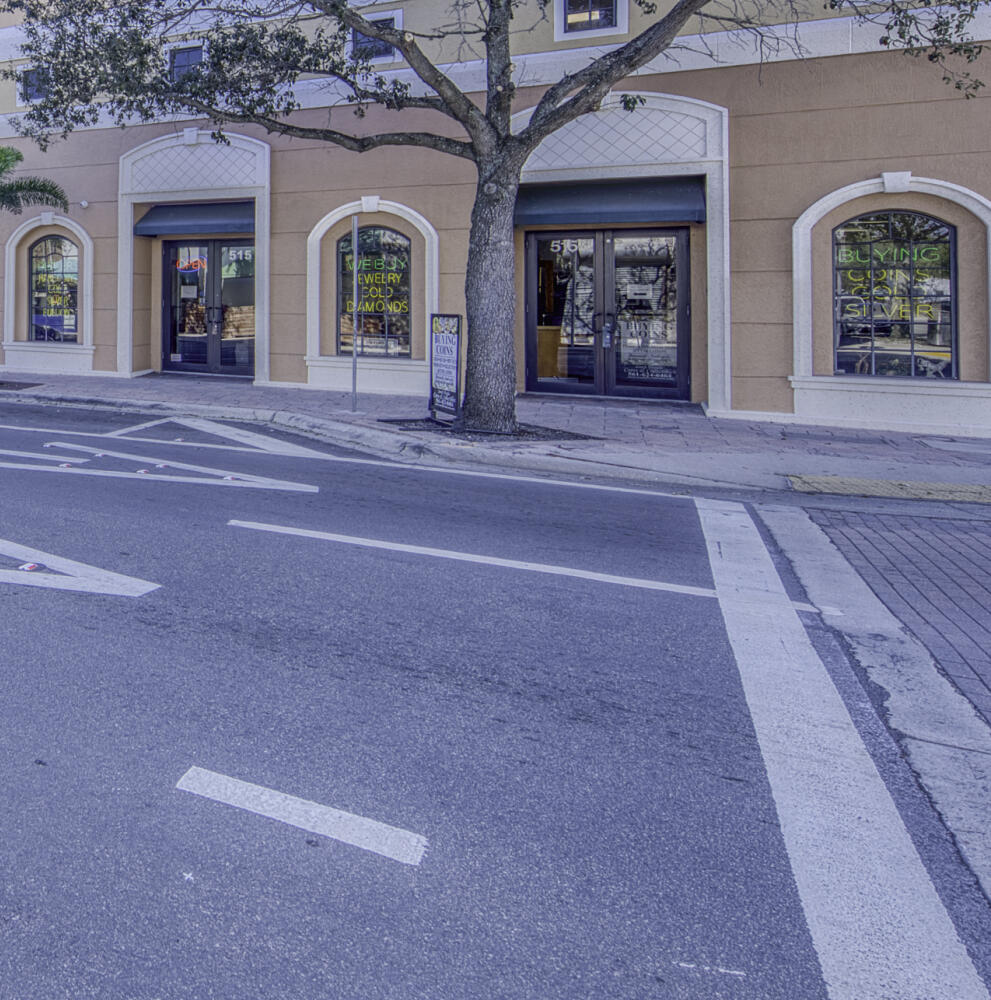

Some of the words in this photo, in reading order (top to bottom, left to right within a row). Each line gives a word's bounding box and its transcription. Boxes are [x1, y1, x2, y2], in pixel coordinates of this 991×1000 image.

[229, 249, 252, 260] 515
[838, 247, 940, 263] BUYING
[176, 258, 207, 270] OPEN
[347, 257, 372, 271] WE
[374, 257, 407, 271] BUY
[352, 273, 402, 285] EWELRY
[848, 269, 929, 282] COINS
[362, 286, 394, 298] GOLD
[851, 286, 926, 299] GOLD
[346, 301, 409, 313] DAMONDS
